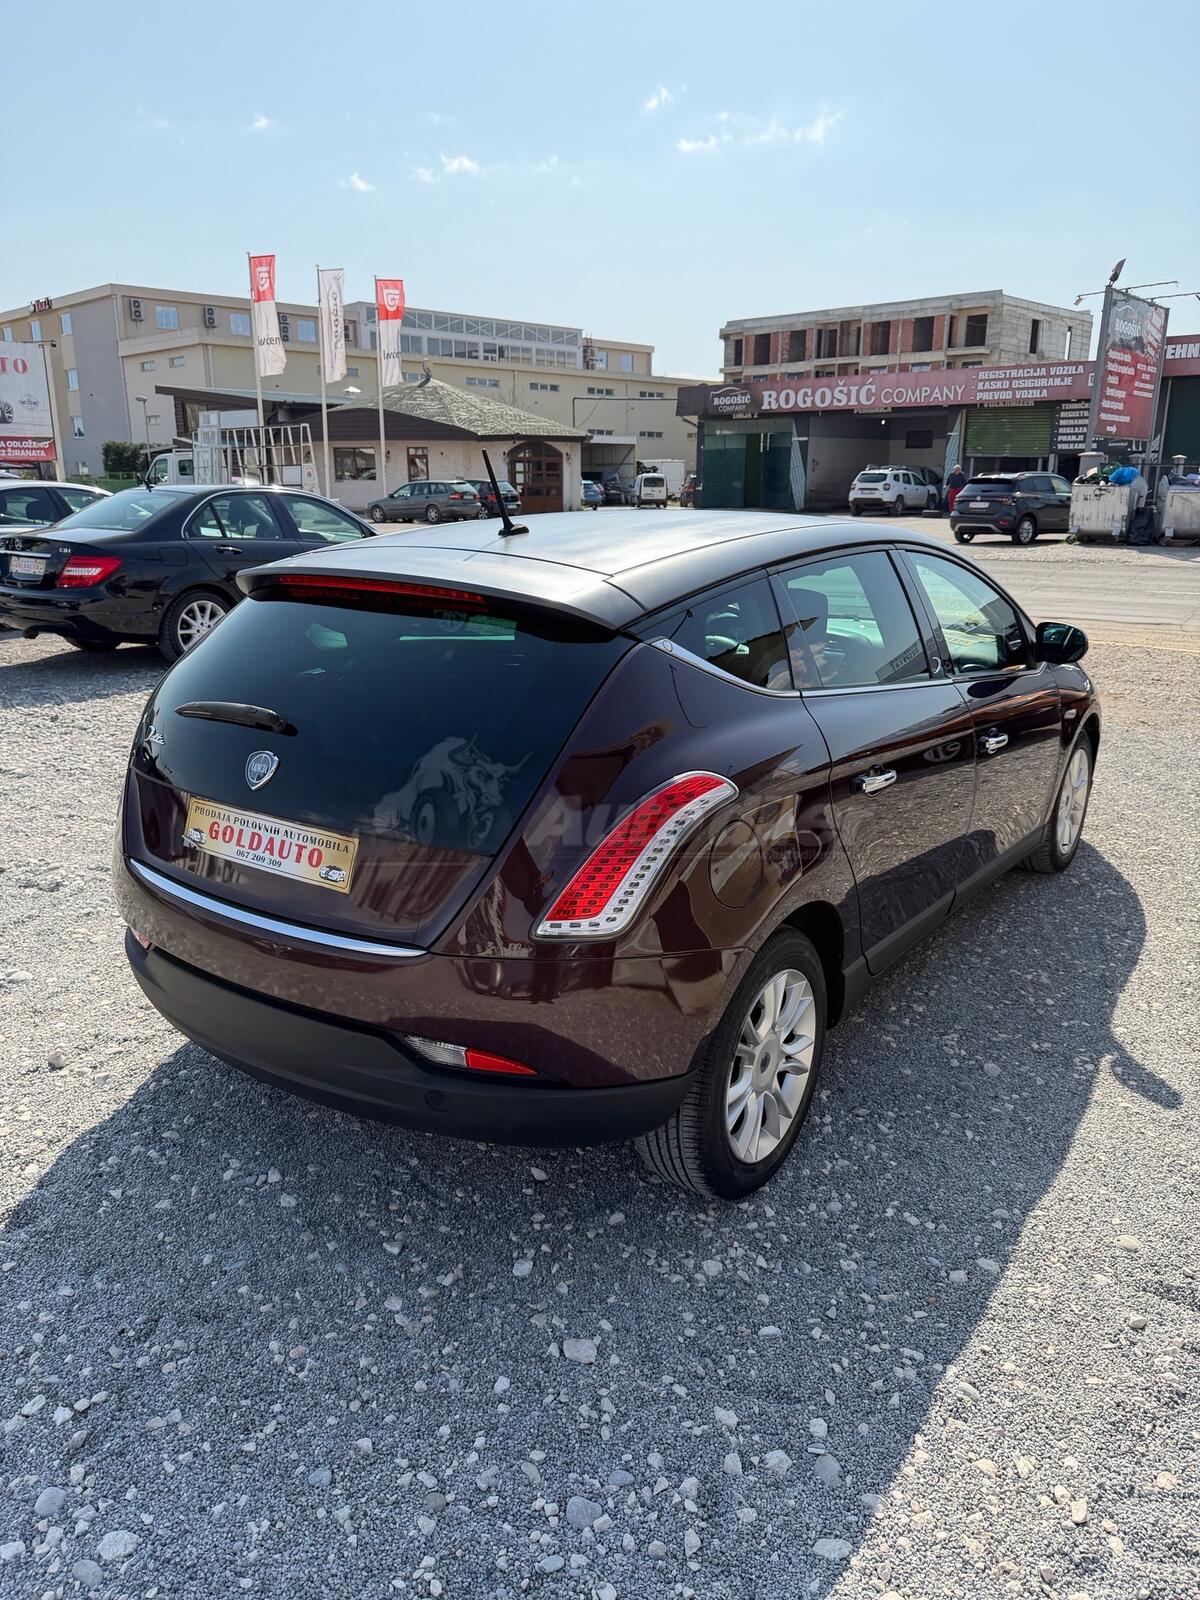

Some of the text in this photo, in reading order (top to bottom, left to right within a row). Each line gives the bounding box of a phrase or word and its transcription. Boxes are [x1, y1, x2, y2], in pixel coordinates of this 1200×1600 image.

[1164, 343, 1200, 360] EHN
[978, 365, 1084, 380] REGISTRACIJA VOZILA
[977, 376, 1073, 390] KASKO OSIGURANJE
[713, 393, 751, 406] ROGOŠIĆ
[761, 378, 966, 410] ROGOŠIĆ COMPANY
[976, 389, 1048, 401] PREVOD VOZILA
[718, 405, 746, 413] COMPANY
[6, 439, 49, 449] ODLOŽENO
[7, 448, 47, 457] ŽIRANATA
[194, 805, 350, 854] PRODAJA POLOVNIH AUTOMOBILA
[208, 821, 323, 869] GOLDAUTO
[236, 849, 282, 869] 067 209 309
